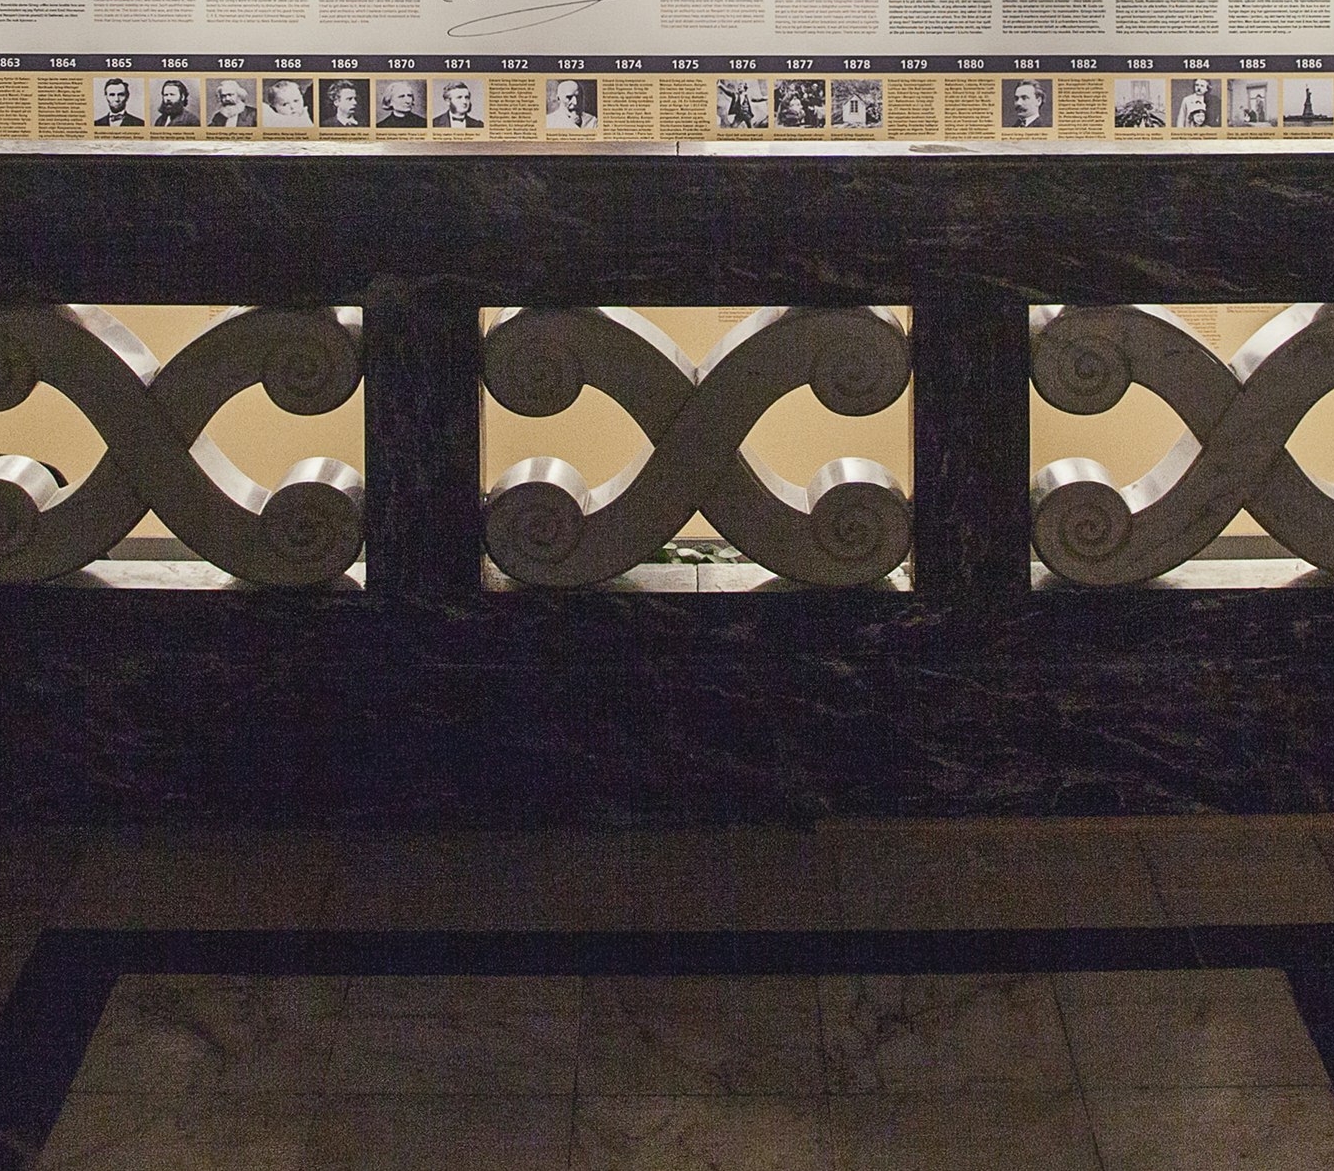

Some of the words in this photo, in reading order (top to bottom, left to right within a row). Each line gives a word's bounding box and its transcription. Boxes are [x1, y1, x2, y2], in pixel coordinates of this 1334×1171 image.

[50, 57, 76, 68] 1864
[106, 58, 132, 68] 1865
[161, 58, 189, 68] 1866
[218, 58, 245, 69] 1867
[274, 58, 302, 69] 1868
[331, 58, 359, 69] 1869
[388, 58, 415, 69] 1870
[445, 59, 471, 69] 1871
[501, 59, 528, 69] 1872
[558, 59, 585, 70] 1873
[615, 59, 642, 70] 1874
[672, 59, 699, 70] 1875
[729, 59, 757, 70] 1876
[786, 59, 813, 70] 1877
[843, 59, 871, 70] 1878
[900, 59, 928, 70] 1879
[957, 59, 985, 69] 1880
[1014, 59, 1040, 69] 1881
[1071, 59, 1097, 69] 1882
[1127, 59, 1154, 69] 1883
[1183, 59, 1210, 69] 1884
[1239, 58, 1266, 69] 1885
[1296, 58, 1323, 69] 1886
